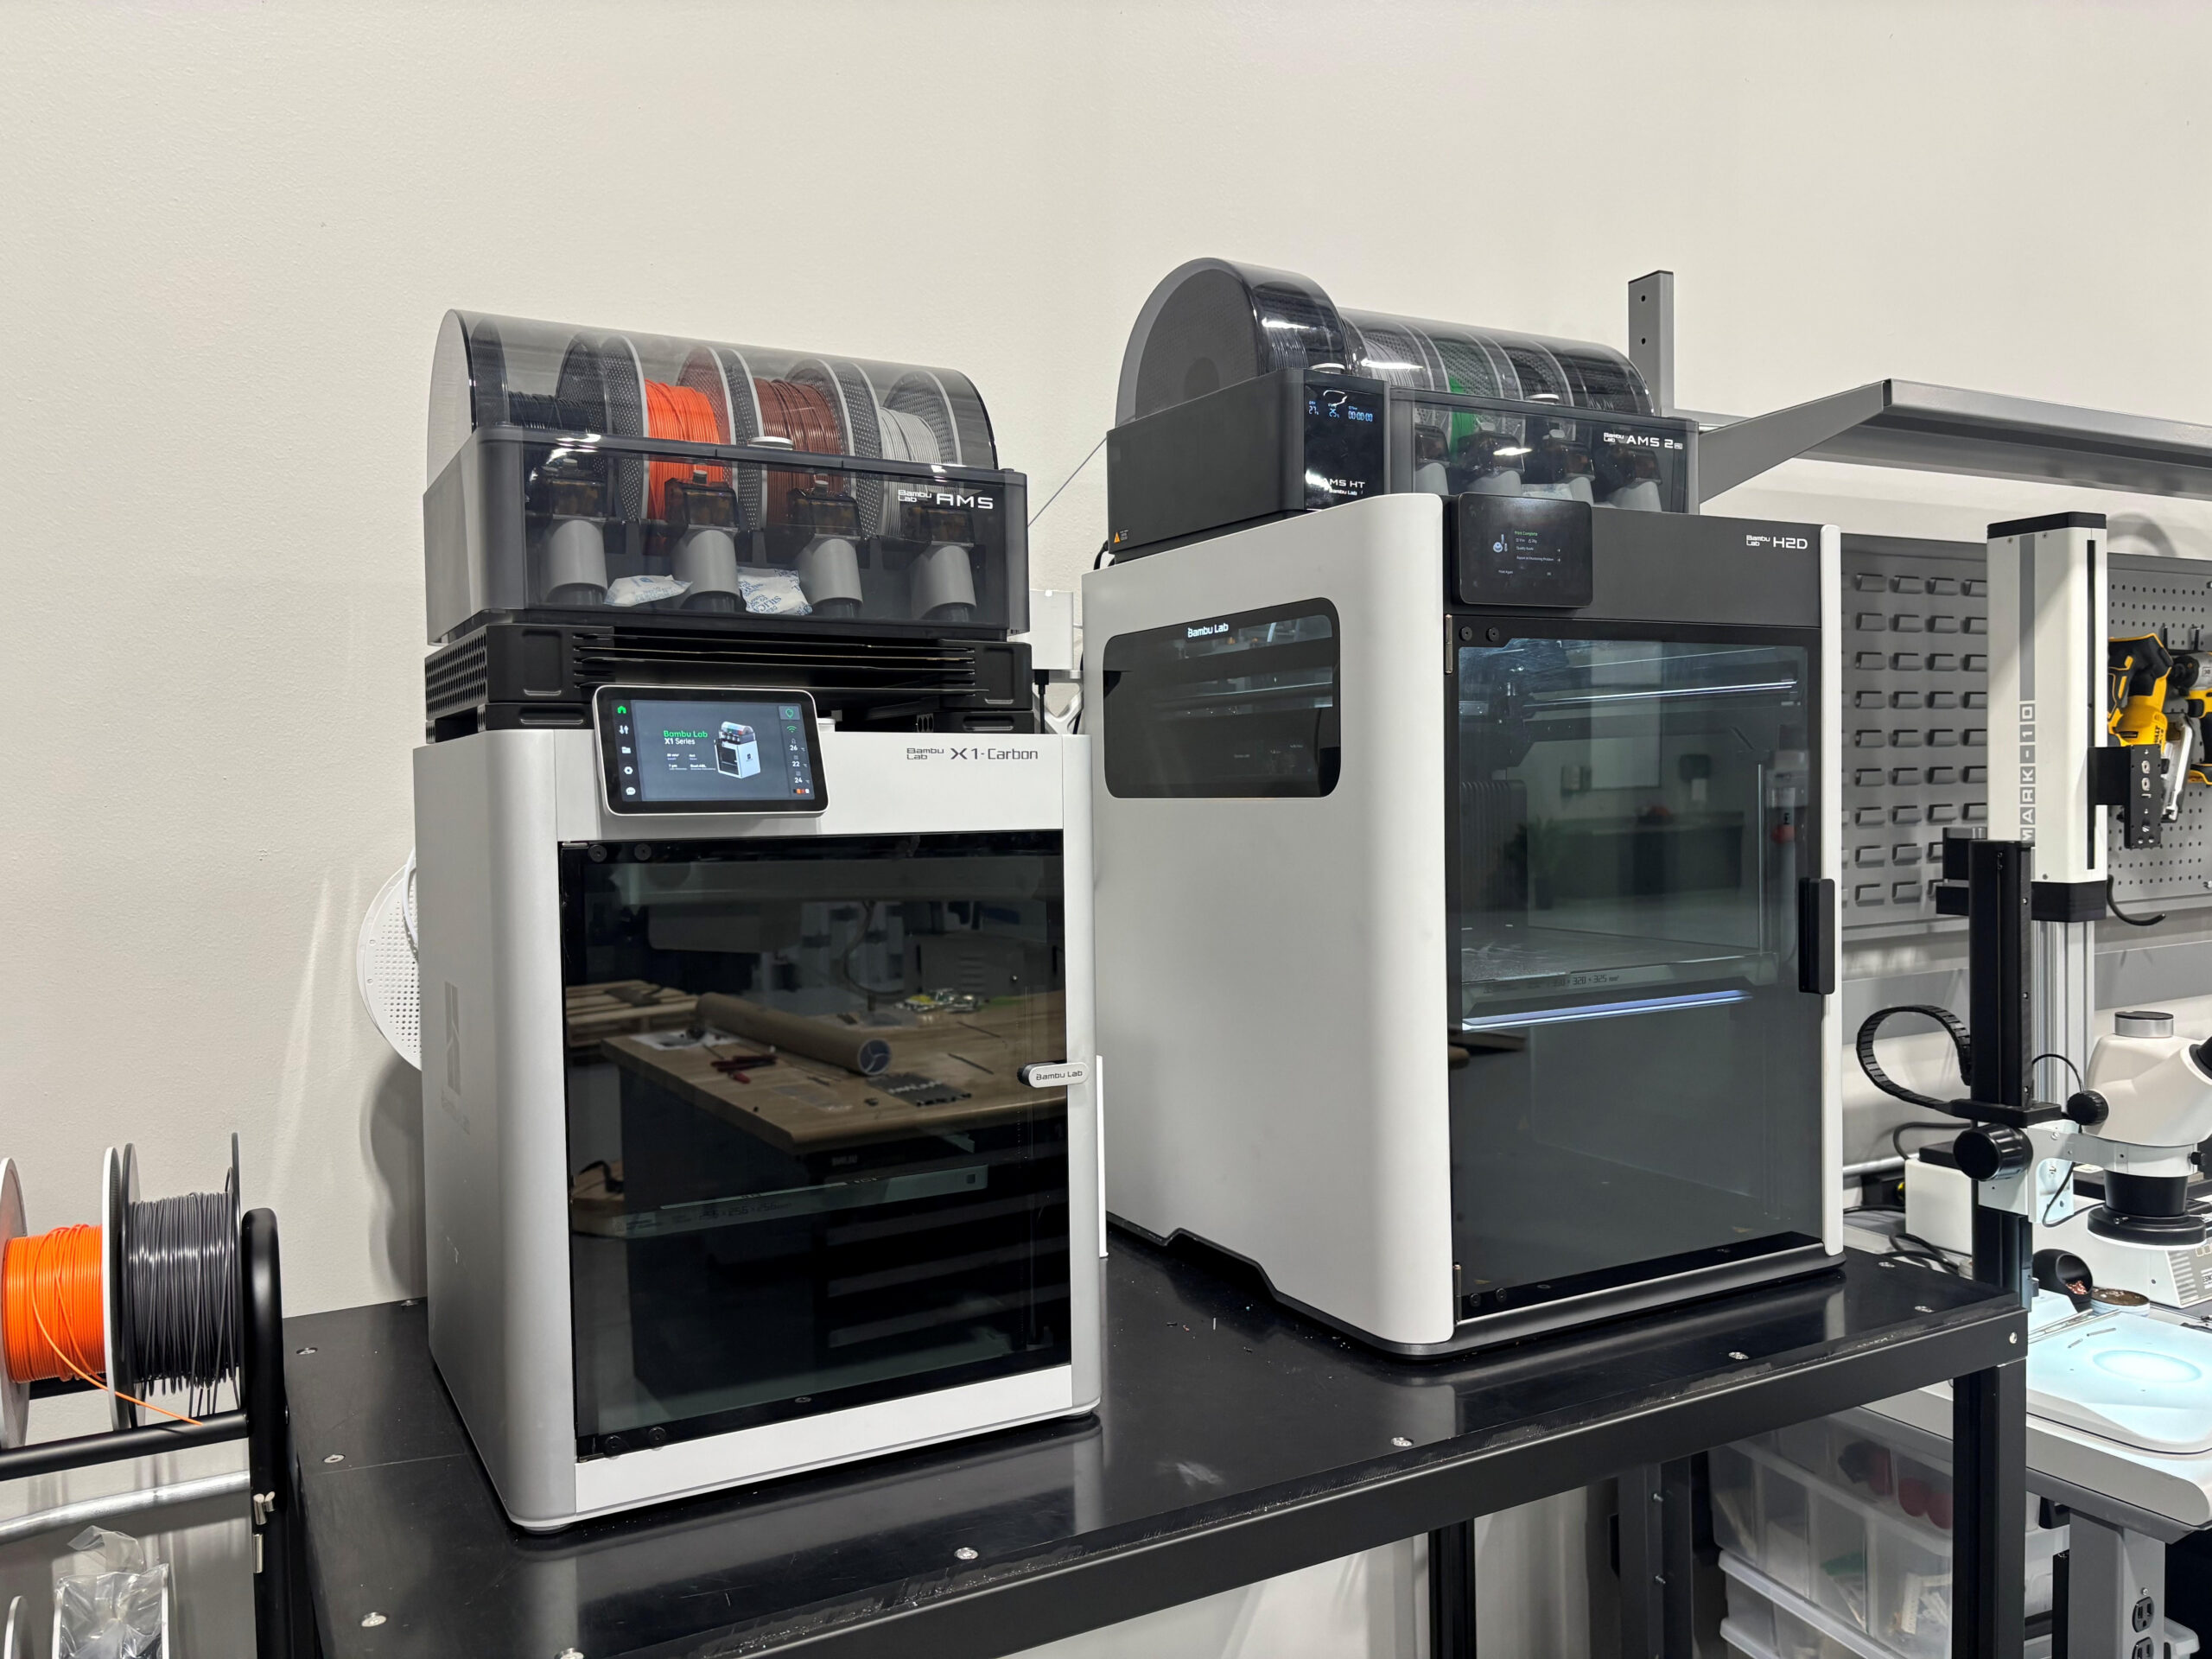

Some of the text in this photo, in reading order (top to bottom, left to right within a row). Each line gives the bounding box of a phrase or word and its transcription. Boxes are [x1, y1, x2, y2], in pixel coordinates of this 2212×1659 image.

[1626, 435, 1659, 447] AMS
[1664, 439, 1674, 448] 2
[1350, 480, 1365, 489] HT
[899, 490, 931, 499] Bambu
[937, 493, 993, 509] AMS
[1773, 537, 1808, 549] H2D
[1187, 623, 1229, 638] Bambu Lab
[1573, 976, 1586, 985] 320
[1036, 1072, 1065, 1081] Bambu
